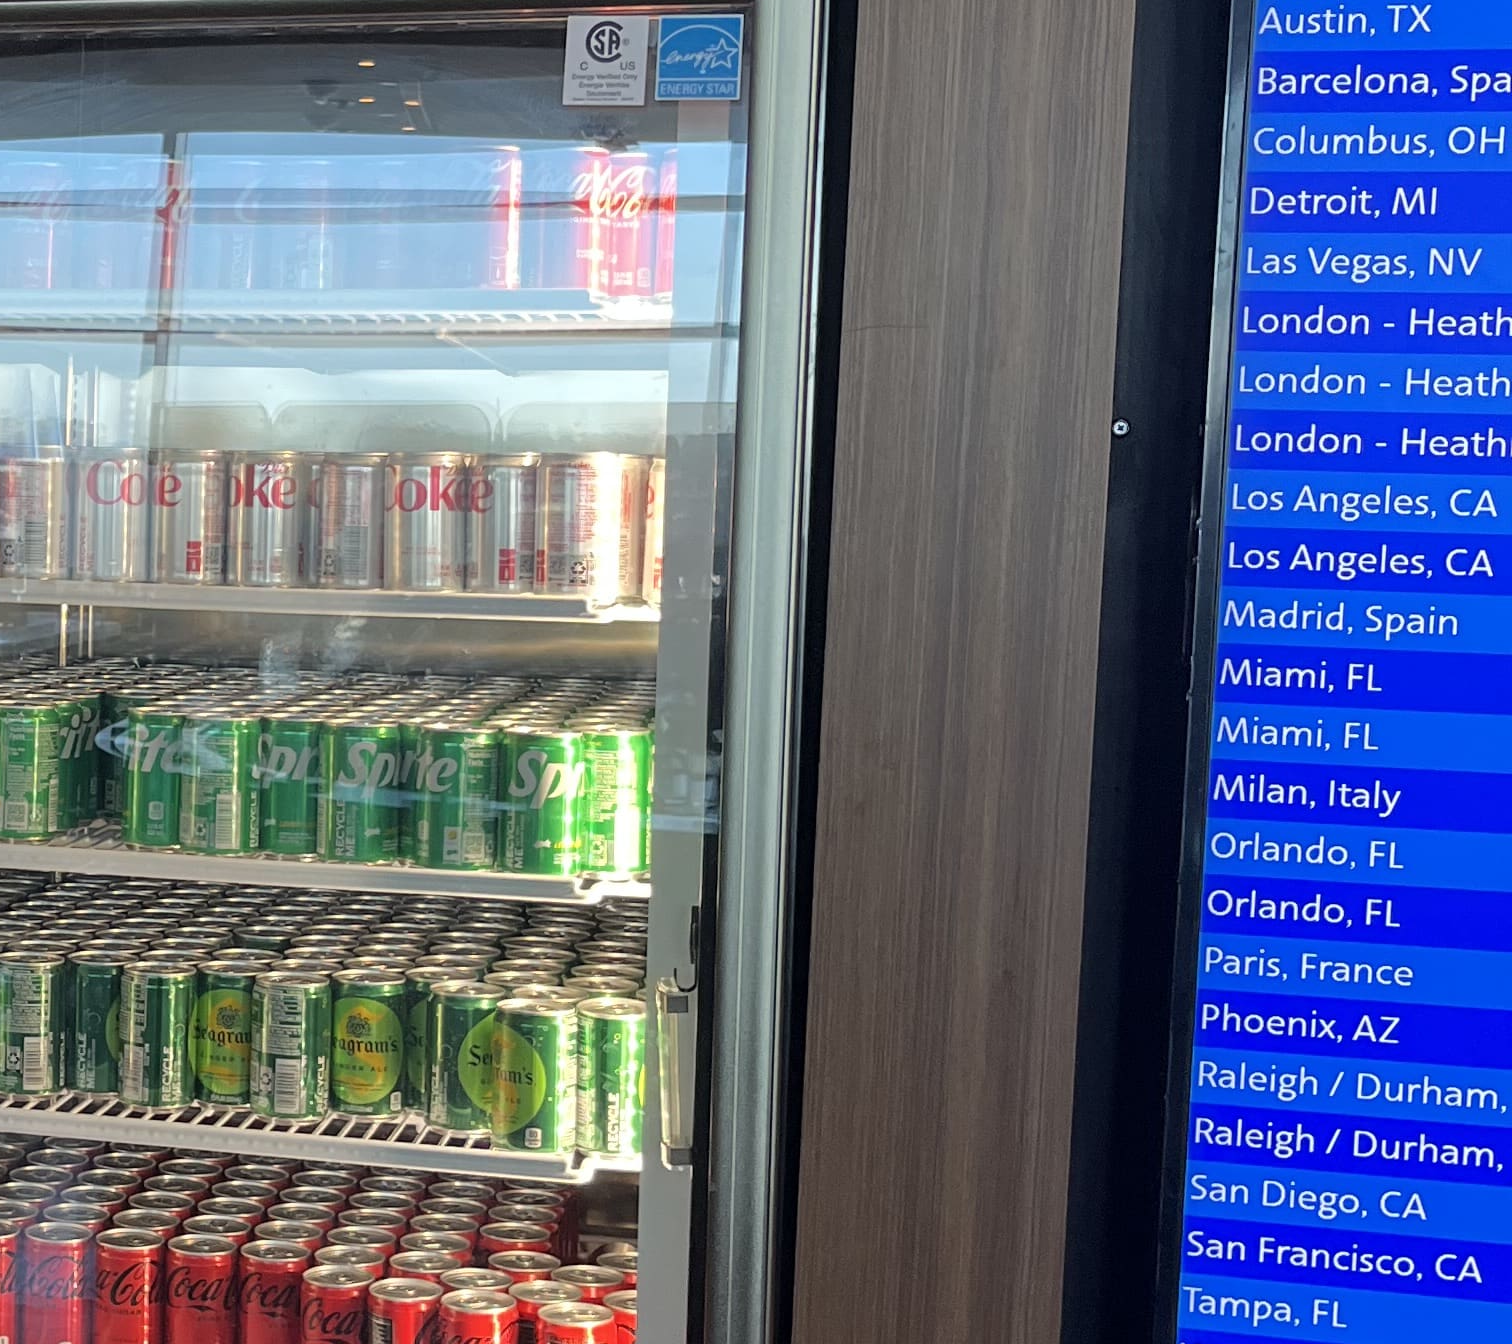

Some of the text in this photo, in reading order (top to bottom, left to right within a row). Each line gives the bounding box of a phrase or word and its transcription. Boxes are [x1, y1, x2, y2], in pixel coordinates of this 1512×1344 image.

[1260, 5, 1431, 37] Austin, TX
[660, 83, 735, 95] ENERGY STAR
[1257, 65, 1438, 97] Barcelona,
[1253, 125, 1505, 157] Columbus, OH
[1250, 186, 1437, 218] Detroit, MI
[1246, 247, 1482, 283] Las Vegas, NV
[1243, 305, 1369, 335] London
[1239, 365, 1366, 394] London
[1235, 425, 1361, 454] London
[1401, 427, 1512, 457] Heath
[1232, 483, 1497, 521] Los Angeles, CA
[1229, 542, 1493, 580] Los Angeles, CA
[1224, 600, 1458, 640] Madrid, Spain
[1220, 659, 1382, 692] Miami, FL
[1217, 716, 1378, 750] Miami, FL
[1214, 774, 1401, 817] Milan, Italy
[1210, 832, 1404, 869] Orlando, FL
[1207, 890, 1400, 927] Orlando, FL
[1205, 946, 1413, 987] Paris, France
[1202, 1004, 1400, 1044] Phoenix, AZ
[1198, 1061, 1507, 1114] Raleigh / Durham,
[1195, 1118, 1503, 1171] Raleigh / Durham,
[1191, 1175, 1427, 1221] San Diego, CA
[1187, 1231, 1483, 1283] San Francisco, CA
[1184, 1286, 1347, 1327] Tampa, FL
